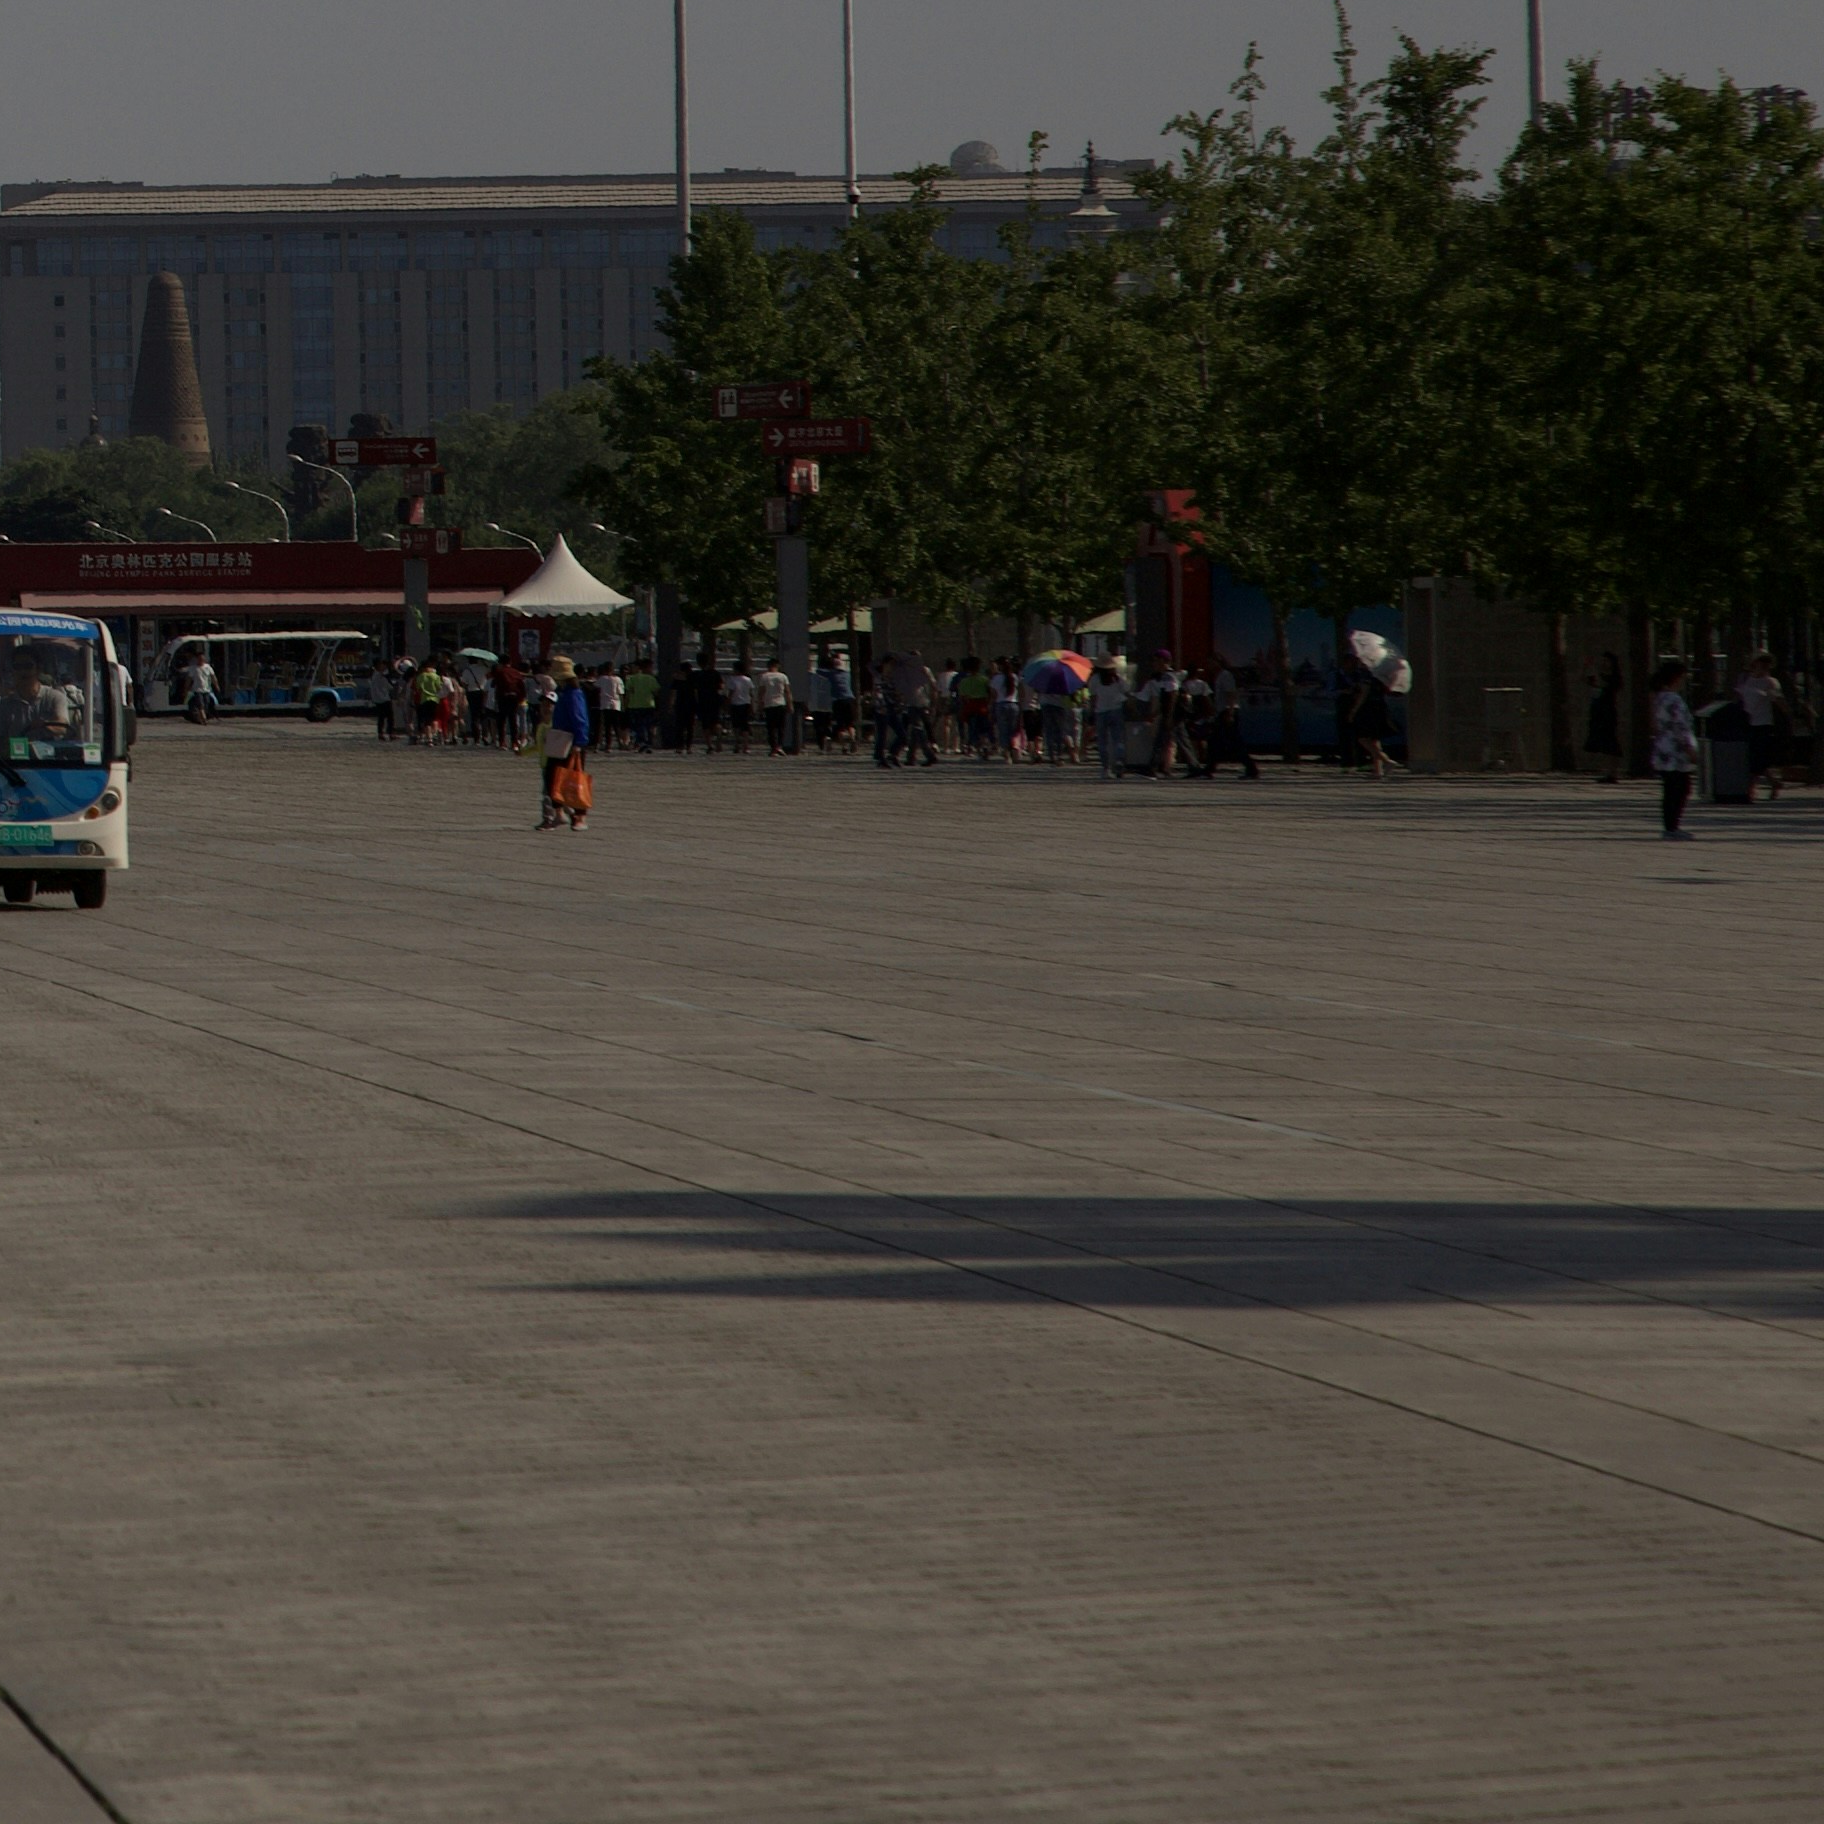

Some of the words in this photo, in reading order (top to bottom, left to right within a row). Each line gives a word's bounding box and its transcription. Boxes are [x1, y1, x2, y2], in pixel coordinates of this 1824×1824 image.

[79, 552, 252, 569] 北京奥林匹克公园服务站
